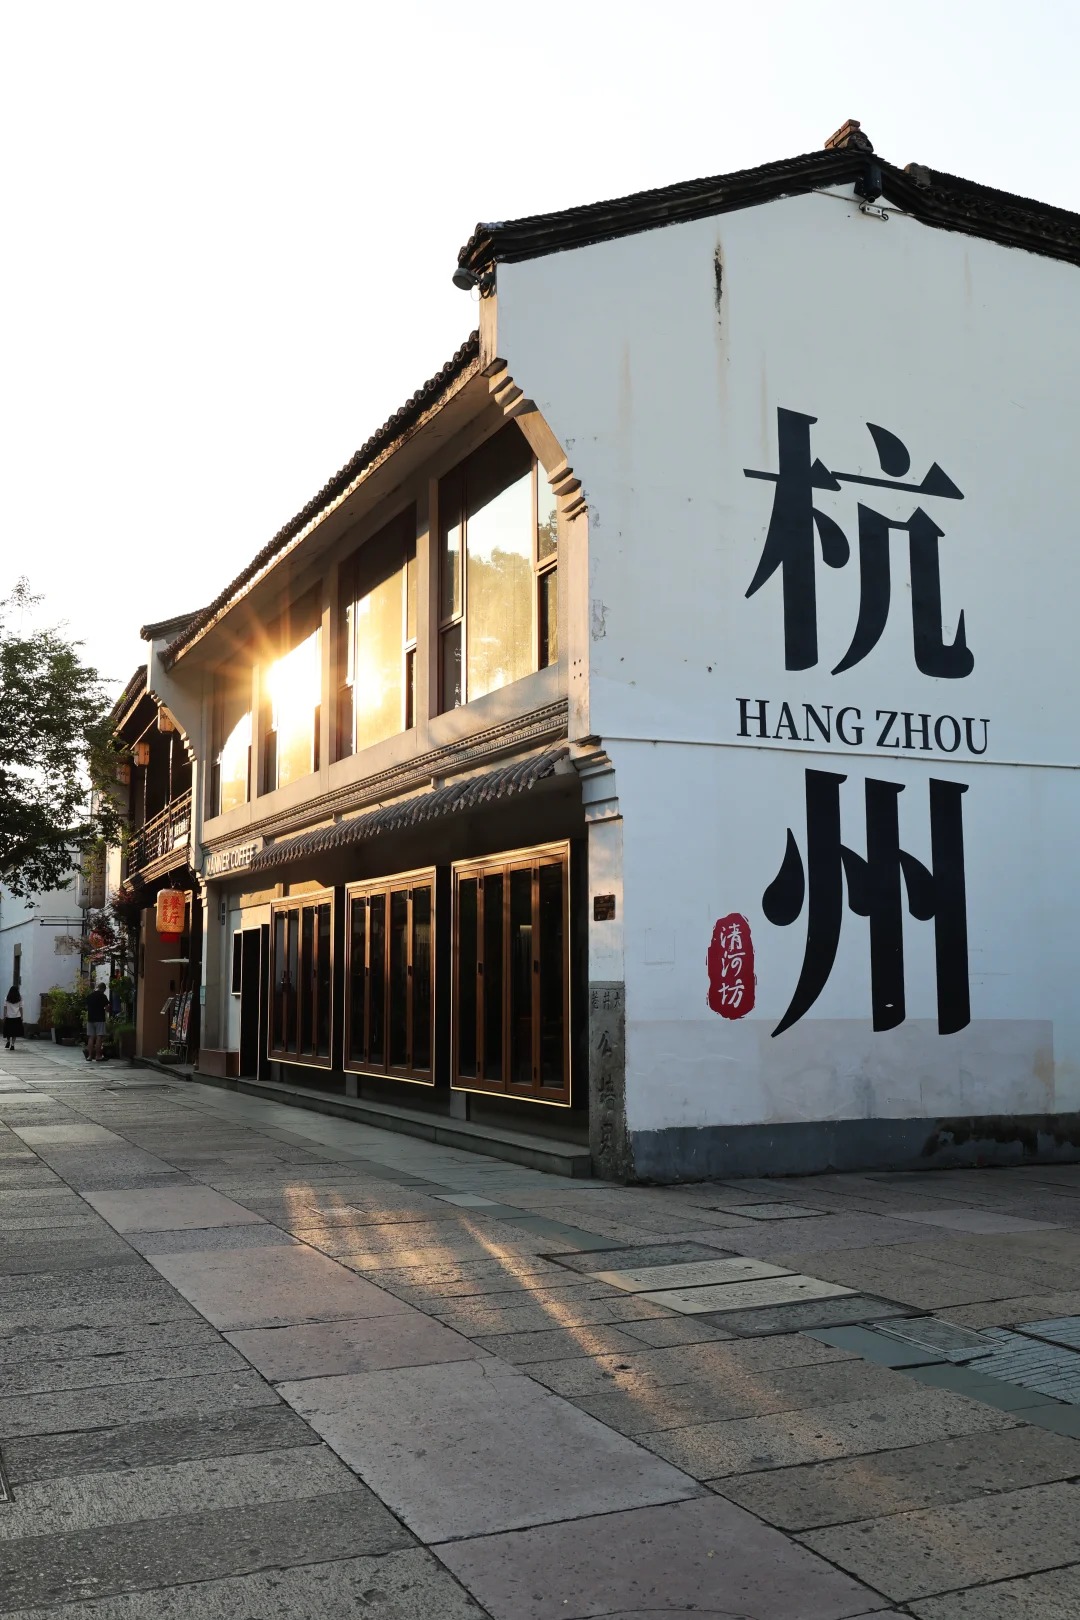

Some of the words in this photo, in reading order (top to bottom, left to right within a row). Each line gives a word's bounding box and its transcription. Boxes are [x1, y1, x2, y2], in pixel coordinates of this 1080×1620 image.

[744, 407, 974, 679] 杭
[736, 698, 865, 746] HANG
[875, 710, 991, 755] ZHOU
[206, 852, 230, 875] MANNER
[230, 844, 255, 868] COFFEE
[762, 768, 971, 1038] 州
[718, 923, 746, 1008] 清河坊
